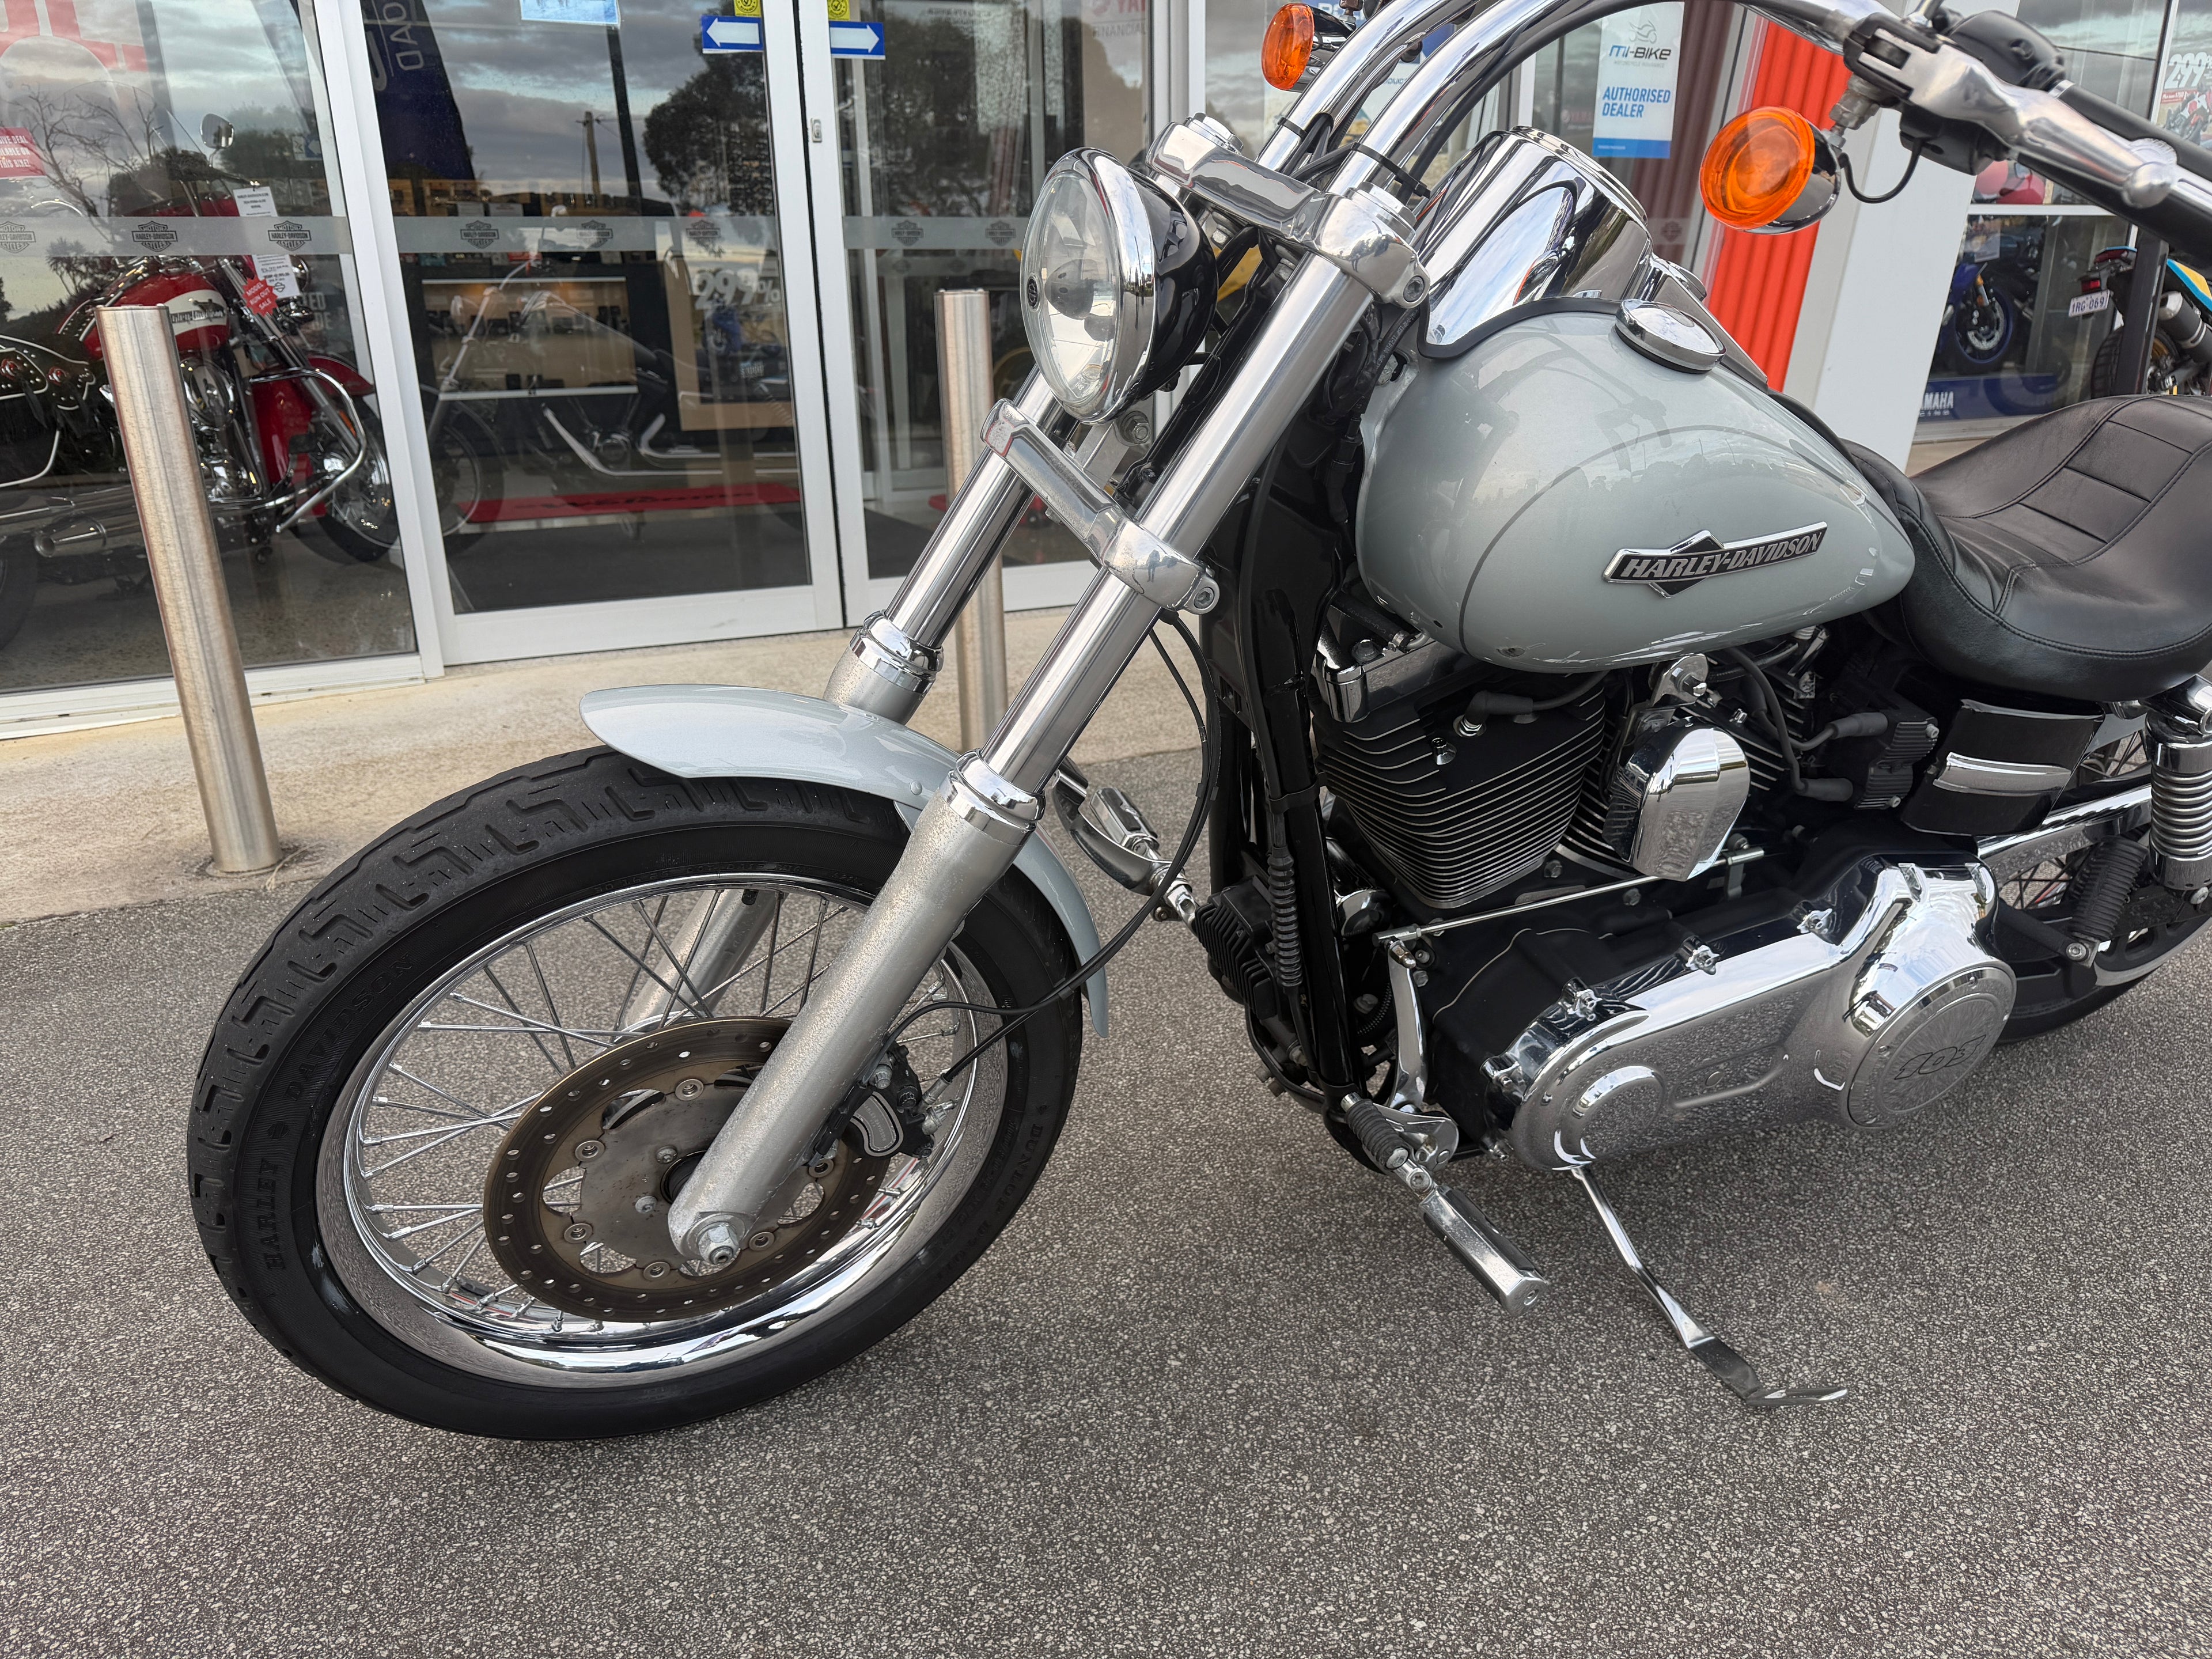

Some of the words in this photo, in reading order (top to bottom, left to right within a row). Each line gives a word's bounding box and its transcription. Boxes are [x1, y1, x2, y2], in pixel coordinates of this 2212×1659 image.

[1603, 86, 1671, 103] AUTHORISED
[1602, 103, 1644, 118] DEALER
[12, 135, 28, 143] DEAL
[247, 282, 263, 296] MODEL
[249, 295, 261, 305] RUN
[260, 287, 270, 298] OUT
[259, 298, 271, 309] SALE
[1921, 392, 1953, 410] MAHA
[1620, 532, 1822, 578] HARLEY-DAVIDSON
[285, 953, 414, 1102] DAVIDSON
[1894, 1035, 1986, 1080] 103
[995, 1123, 1043, 1213] DUNLOP
[257, 1158, 286, 1271] HARLEY
